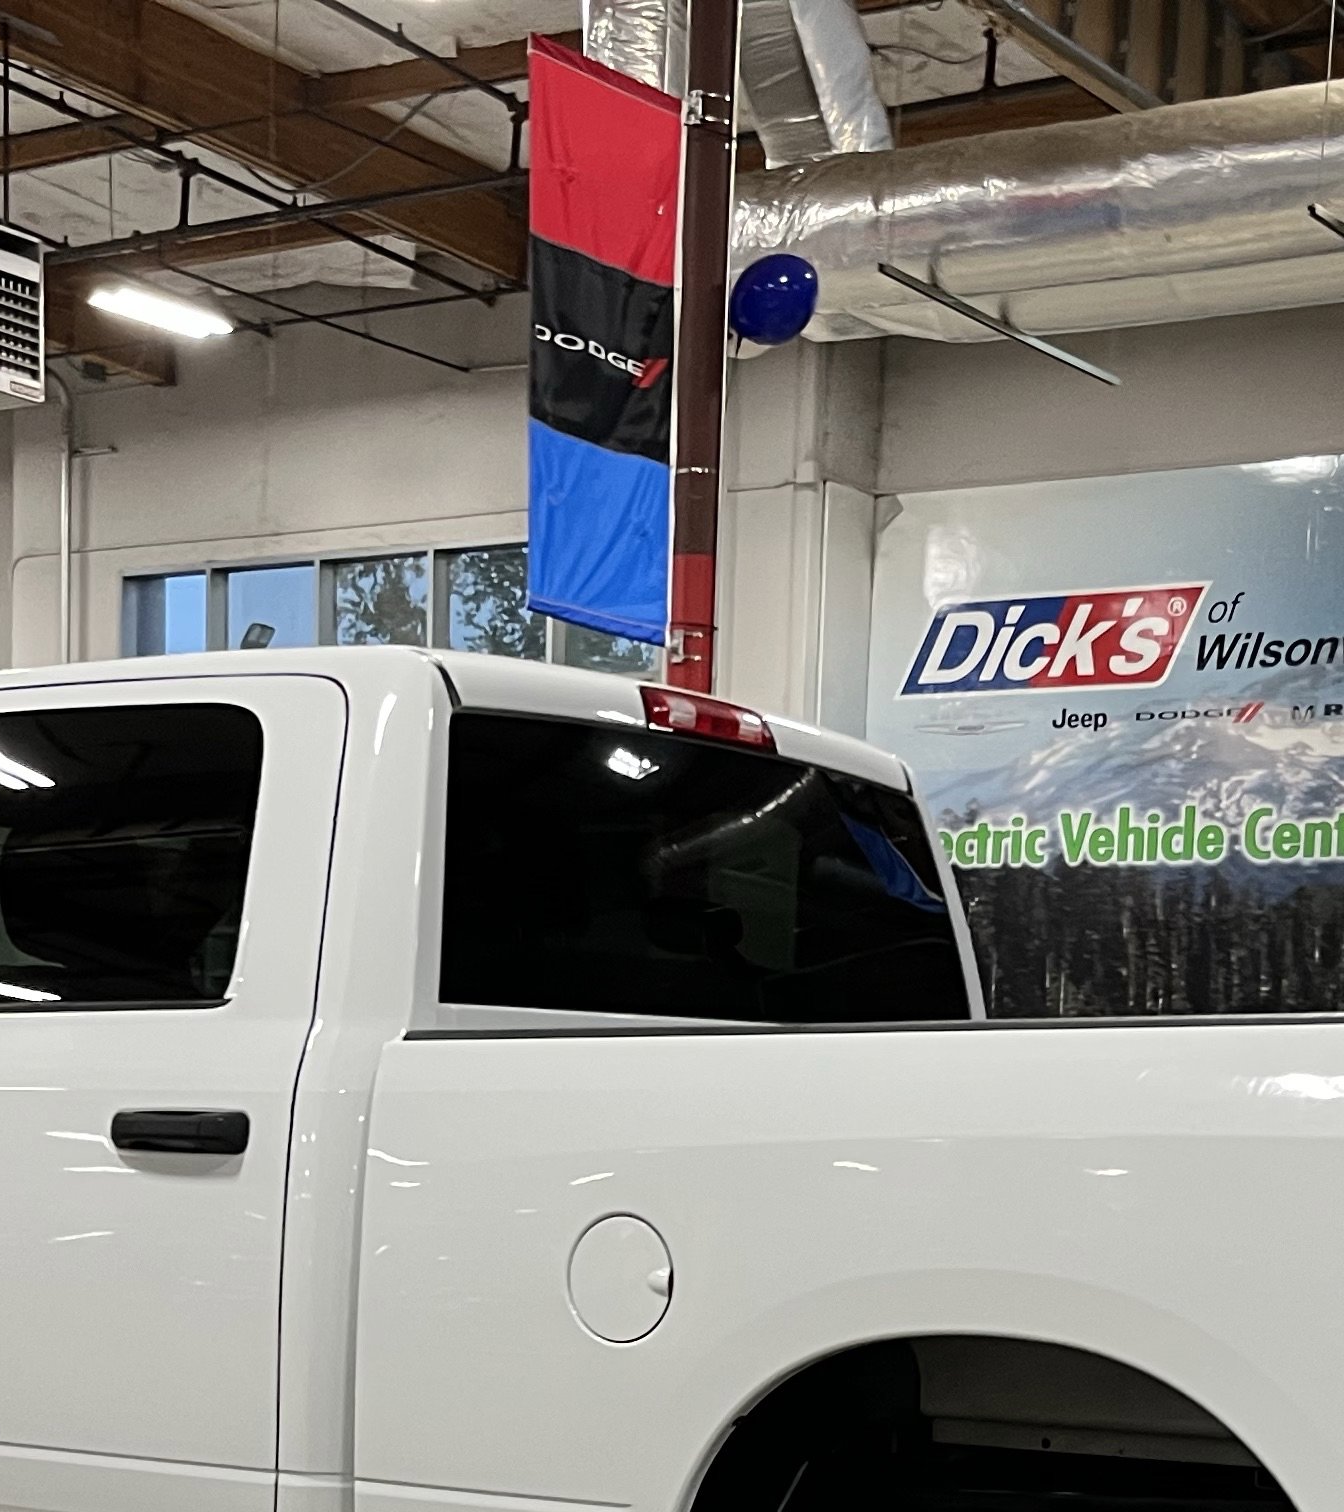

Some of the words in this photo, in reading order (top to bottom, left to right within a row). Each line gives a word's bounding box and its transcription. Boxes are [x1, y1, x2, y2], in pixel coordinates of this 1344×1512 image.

[535, 324, 645, 378] DODGE
[1207, 592, 1246, 624] of
[1052, 708, 1108, 732] Jeep
[1060, 805, 1225, 863] Vehicle
